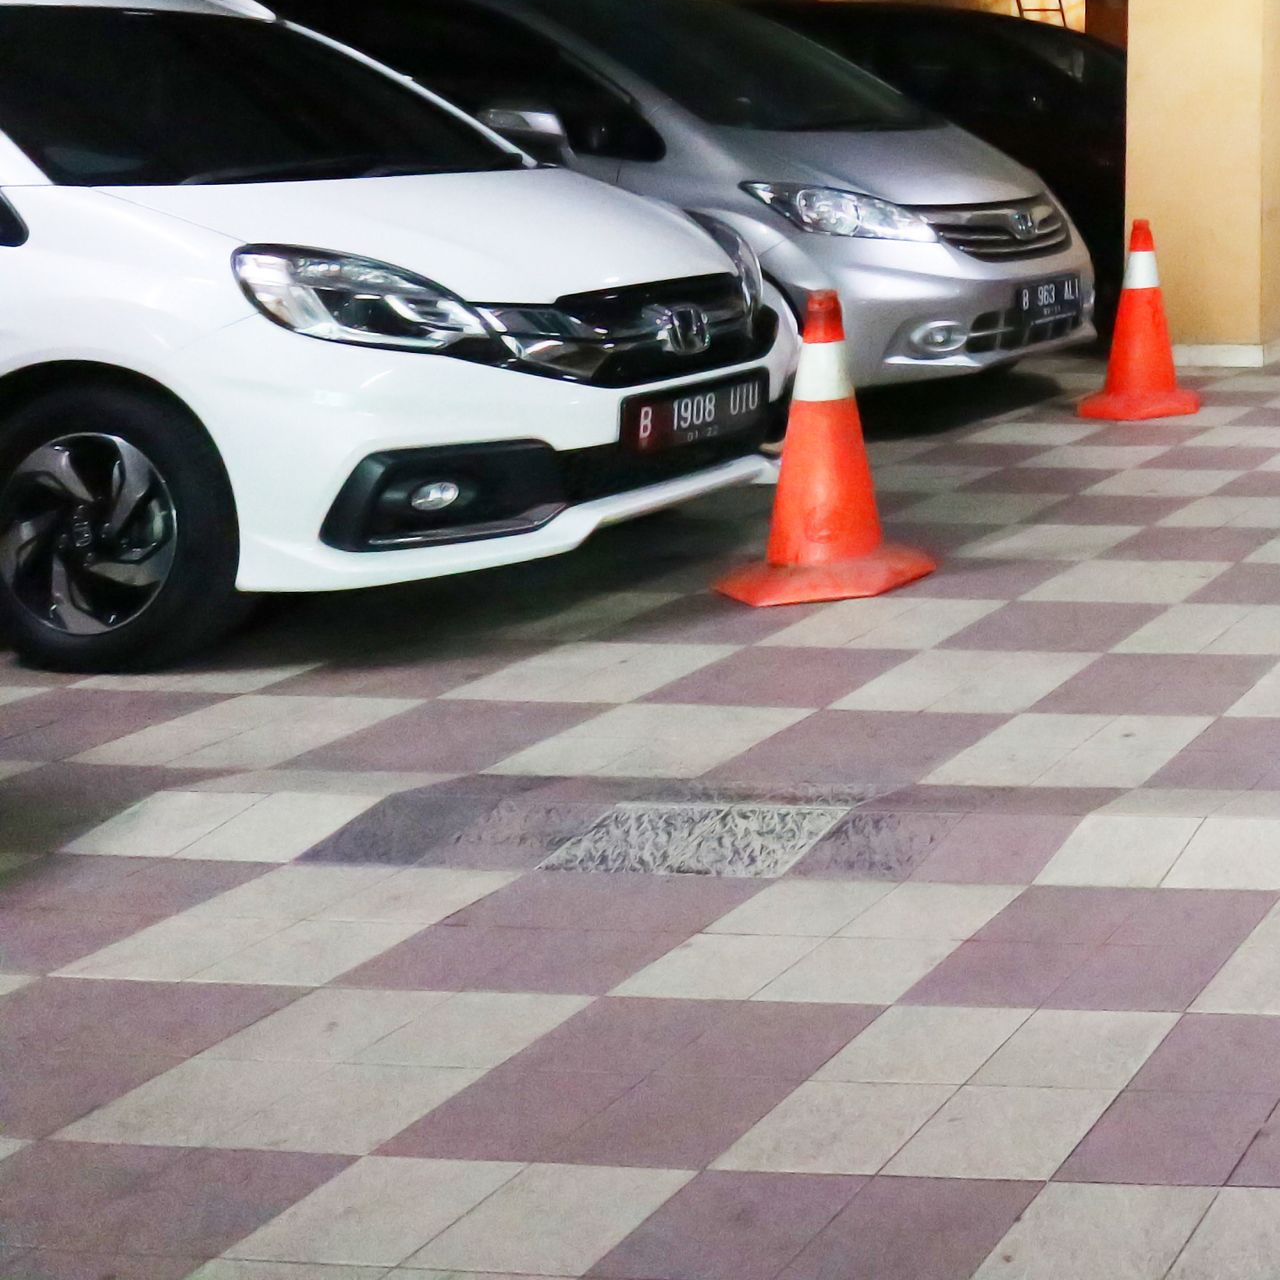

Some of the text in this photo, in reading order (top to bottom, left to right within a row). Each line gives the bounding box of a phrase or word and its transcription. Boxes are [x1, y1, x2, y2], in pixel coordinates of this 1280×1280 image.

[1022, 288, 1030, 312] B
[1037, 283, 1056, 307] 963
[639, 405, 653, 439] B
[672, 392, 716, 431] 1908
